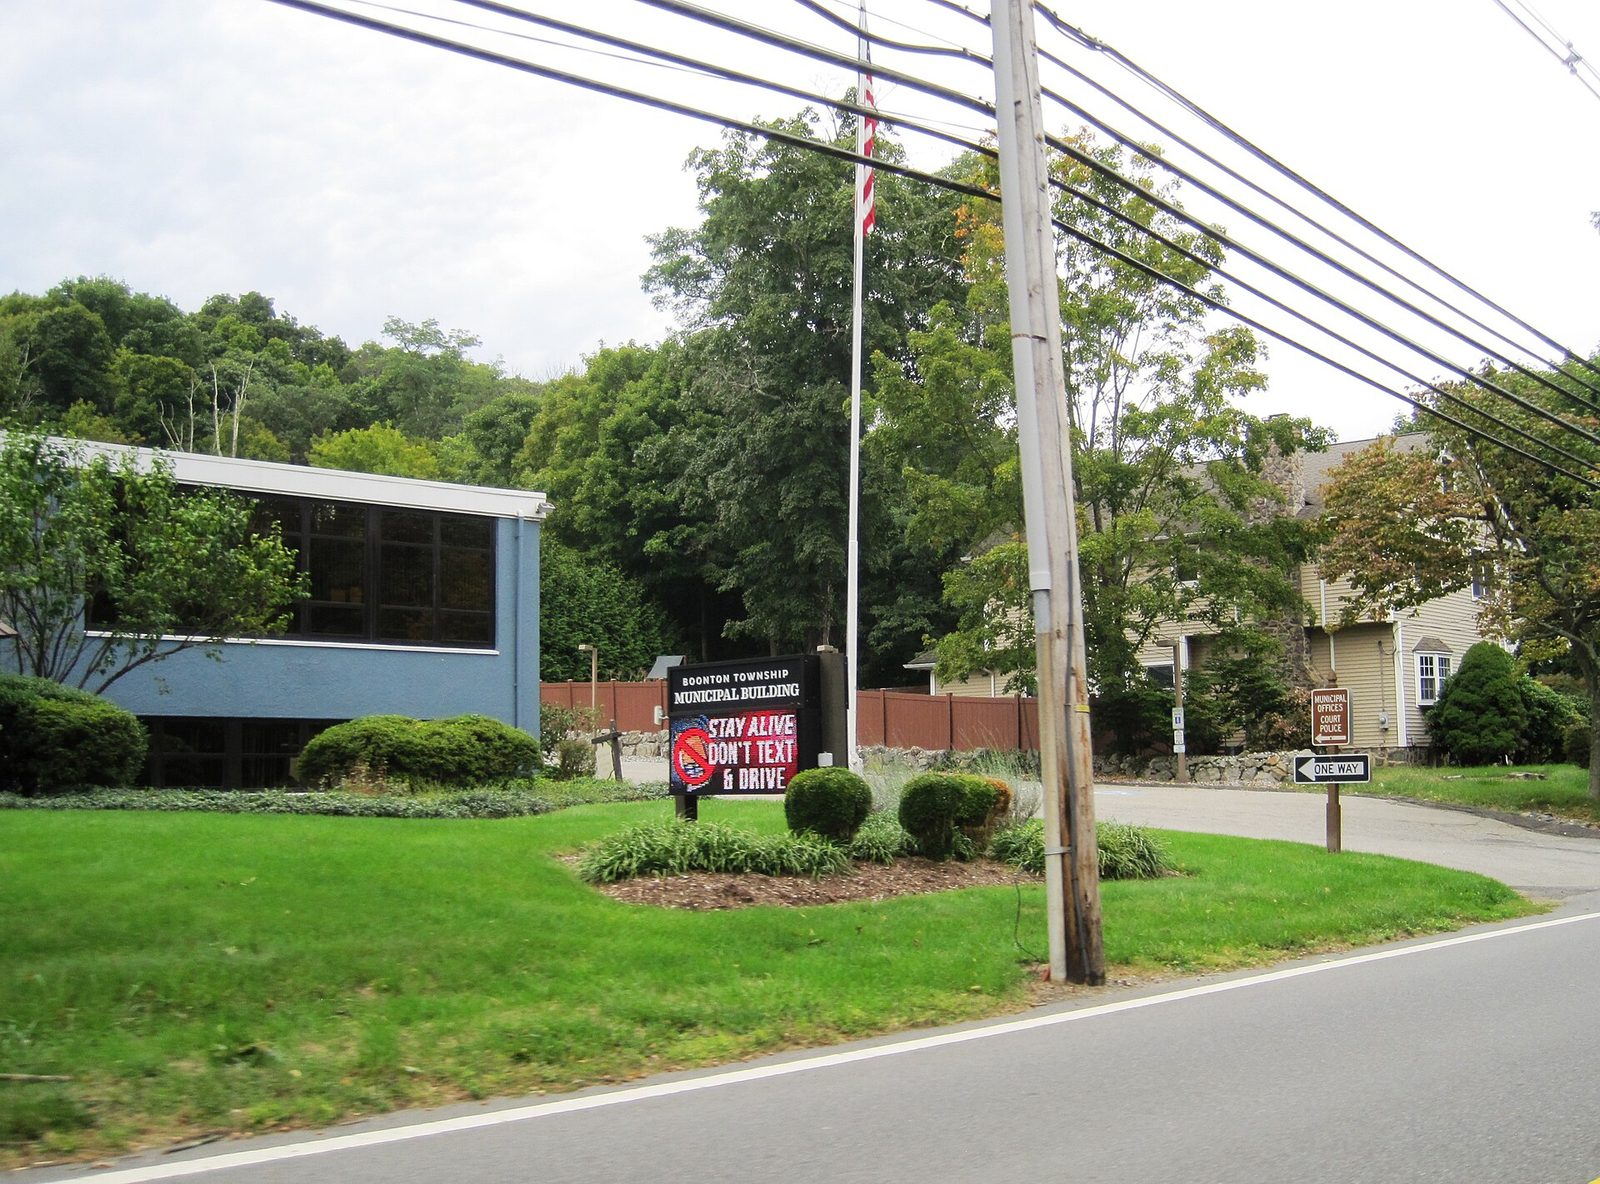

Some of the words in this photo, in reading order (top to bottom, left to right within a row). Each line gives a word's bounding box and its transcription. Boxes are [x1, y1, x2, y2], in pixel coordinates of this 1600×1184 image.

[683, 674, 730, 686] BOONTON
[734, 669, 789, 682] TOWNSHIP
[674, 687, 739, 704] MUNICIPAL
[741, 683, 800, 700] BUILDING
[1314, 694, 1347, 703] MUNICIPAL
[1317, 704, 1343, 712] OFFICES
[708, 717, 746, 738] STAY
[747, 714, 796, 736] ALIVE
[1320, 715, 1341, 723] COURT
[1319, 724, 1342, 732] POLICE
[708, 741, 751, 765] DON'T
[757, 739, 796, 763] TEXT
[1314, 764, 1334, 774] ONE
[1337, 763, 1359, 773] WAY
[723, 769, 733, 790] &
[739, 767, 786, 790] DRIVE
